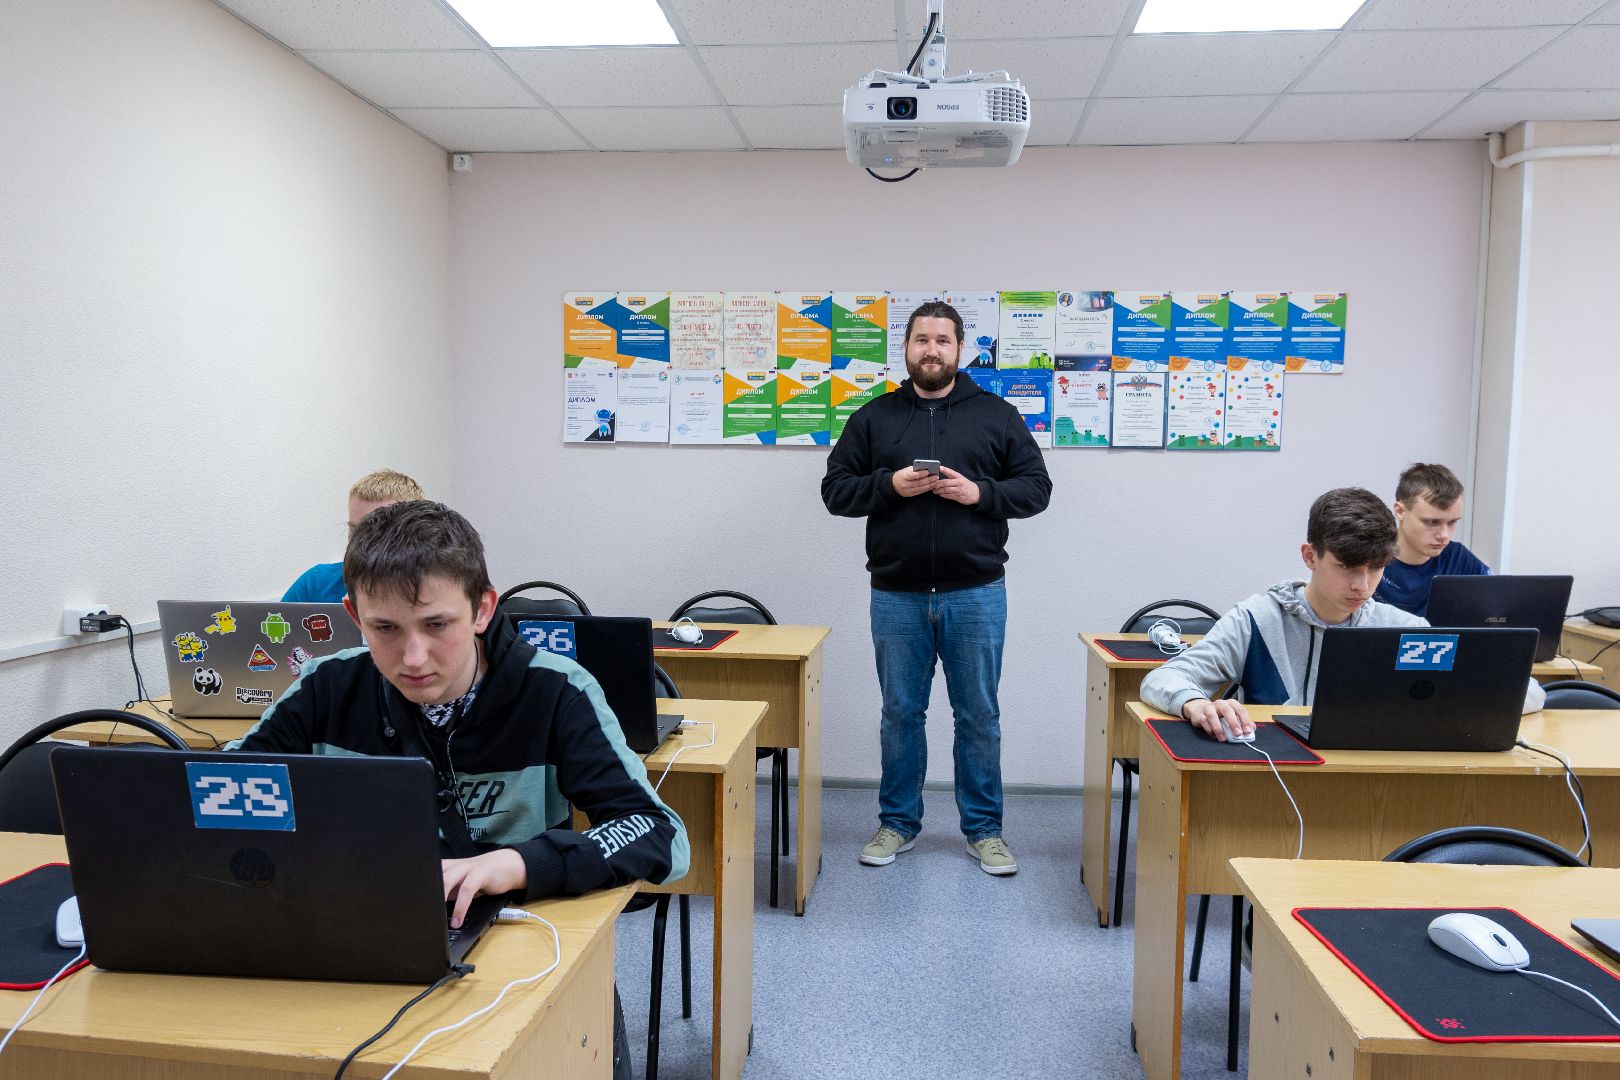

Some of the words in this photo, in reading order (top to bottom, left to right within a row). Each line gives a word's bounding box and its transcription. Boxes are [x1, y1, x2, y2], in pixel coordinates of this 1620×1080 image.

[522, 628, 573, 651] 26
[1400, 641, 1454, 664] 27
[195, 776, 289, 817] 28
[456, 780, 506, 814] EER
